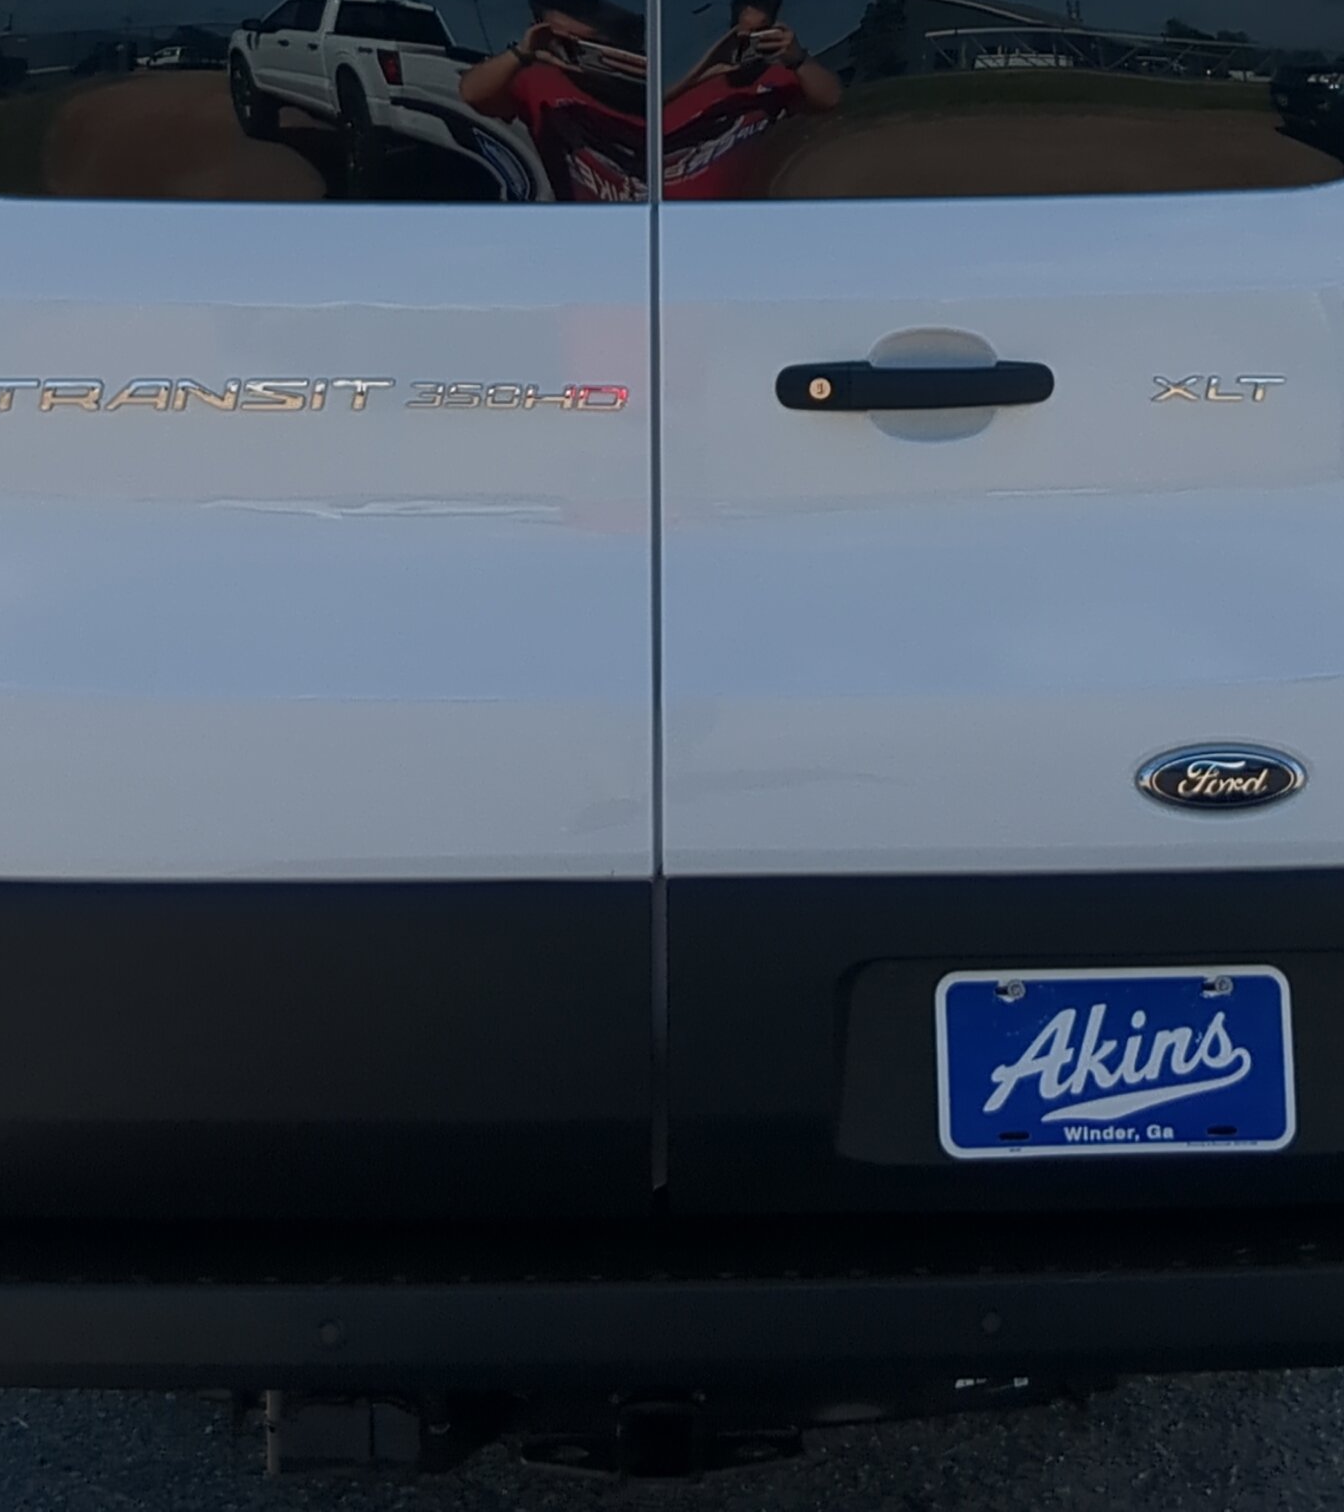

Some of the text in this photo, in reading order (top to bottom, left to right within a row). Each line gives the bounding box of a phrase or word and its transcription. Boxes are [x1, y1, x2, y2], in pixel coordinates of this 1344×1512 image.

[406, 382, 629, 411] 350HD
[1150, 374, 1288, 402] XLT
[1177, 760, 1269, 797] Ford
[982, 1003, 1252, 1118] Akins
[1063, 1123, 1175, 1143] Winder, Ga
